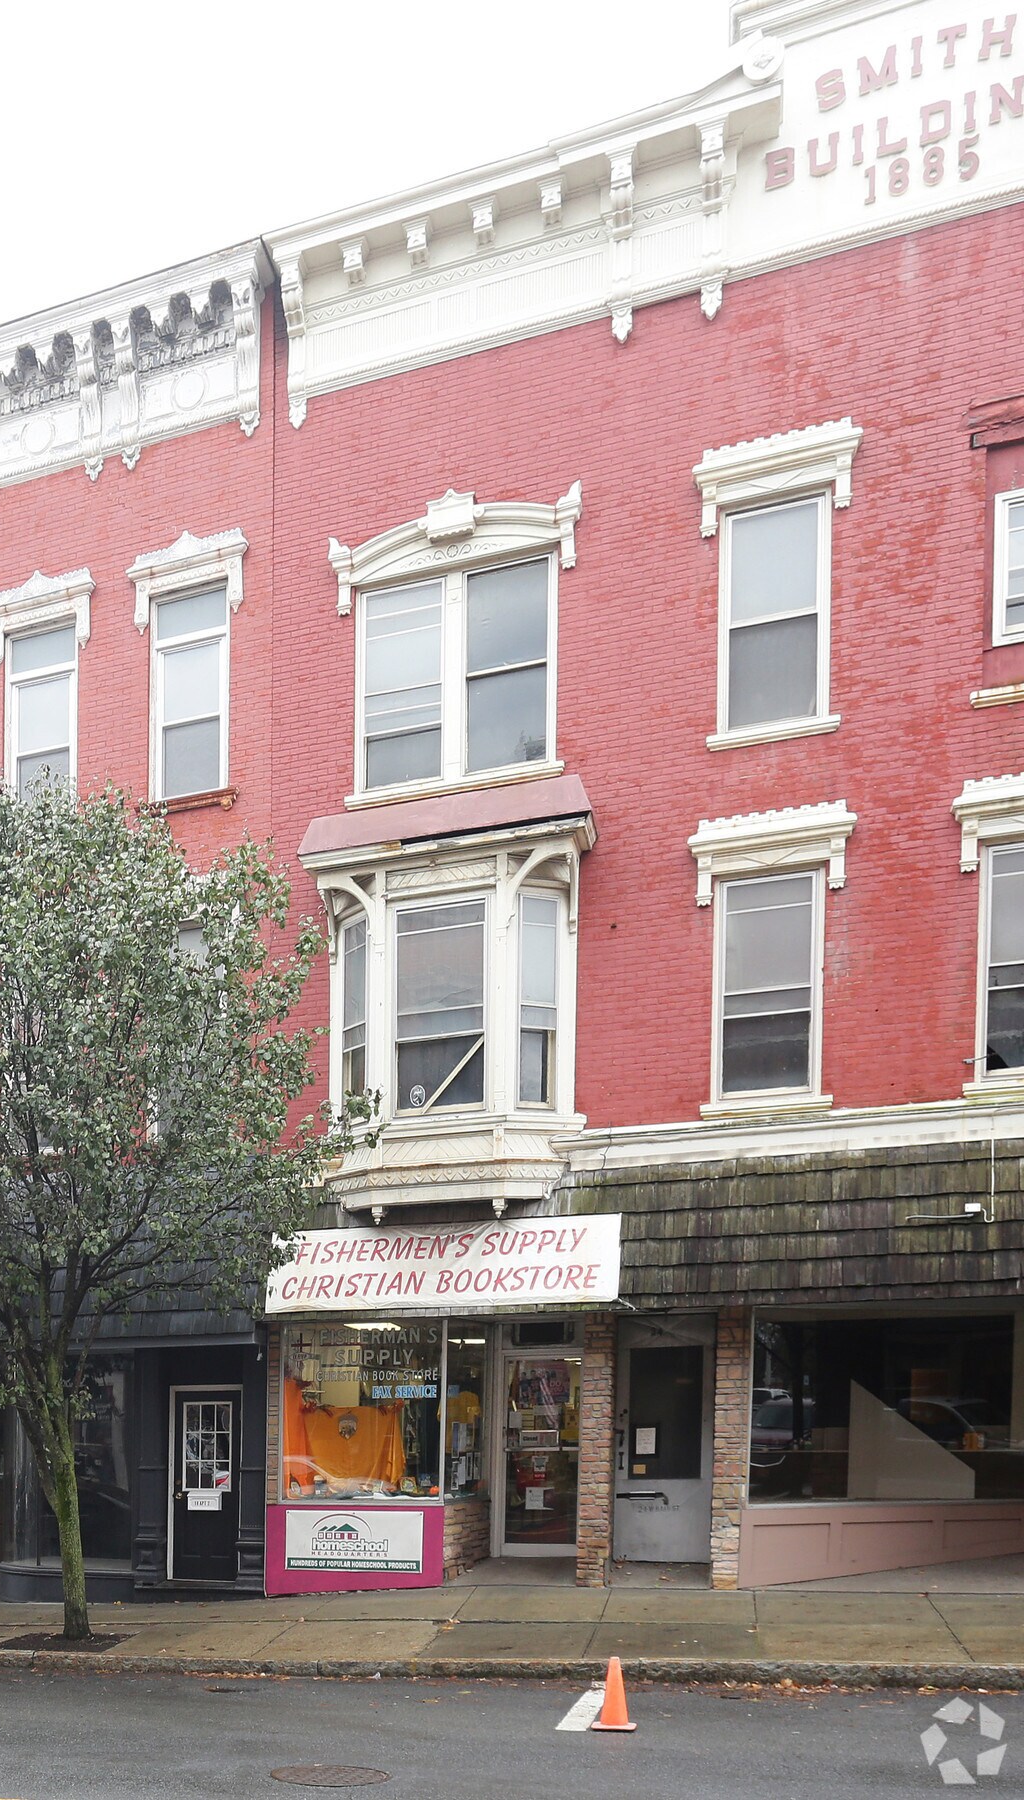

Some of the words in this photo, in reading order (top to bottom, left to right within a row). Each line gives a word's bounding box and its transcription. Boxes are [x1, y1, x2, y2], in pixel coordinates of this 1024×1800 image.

[815, 13, 1017, 112] SMITH
[764, 76, 1024, 192] BUILDIN
[864, 133, 980, 206] 1885
[295, 1233, 474, 1266] FISHERMEN'S
[481, 1227, 588, 1258] SUPPLY
[281, 1270, 426, 1301] CHRISTIAN
[435, 1264, 601, 1295] BOOKSTORE
[334, 1349, 414, 1367] SUPPLY
[316, 1370, 369, 1382] CHRISTIAN
[372, 1370, 399, 1381] BOOK
[403, 1368, 438, 1381] STORE
[372, 1385, 392, 1398] FAX
[395, 1385, 437, 1398] SERVICE
[312, 1537, 388, 1552] homeschool
[290, 1559, 318, 1567] HUNDREDS
[326, 1560, 351, 1568] POPULAR
[351, 1561, 387, 1569] HOMESCHOOL
[388, 1562, 417, 1570] PRODUCTS
